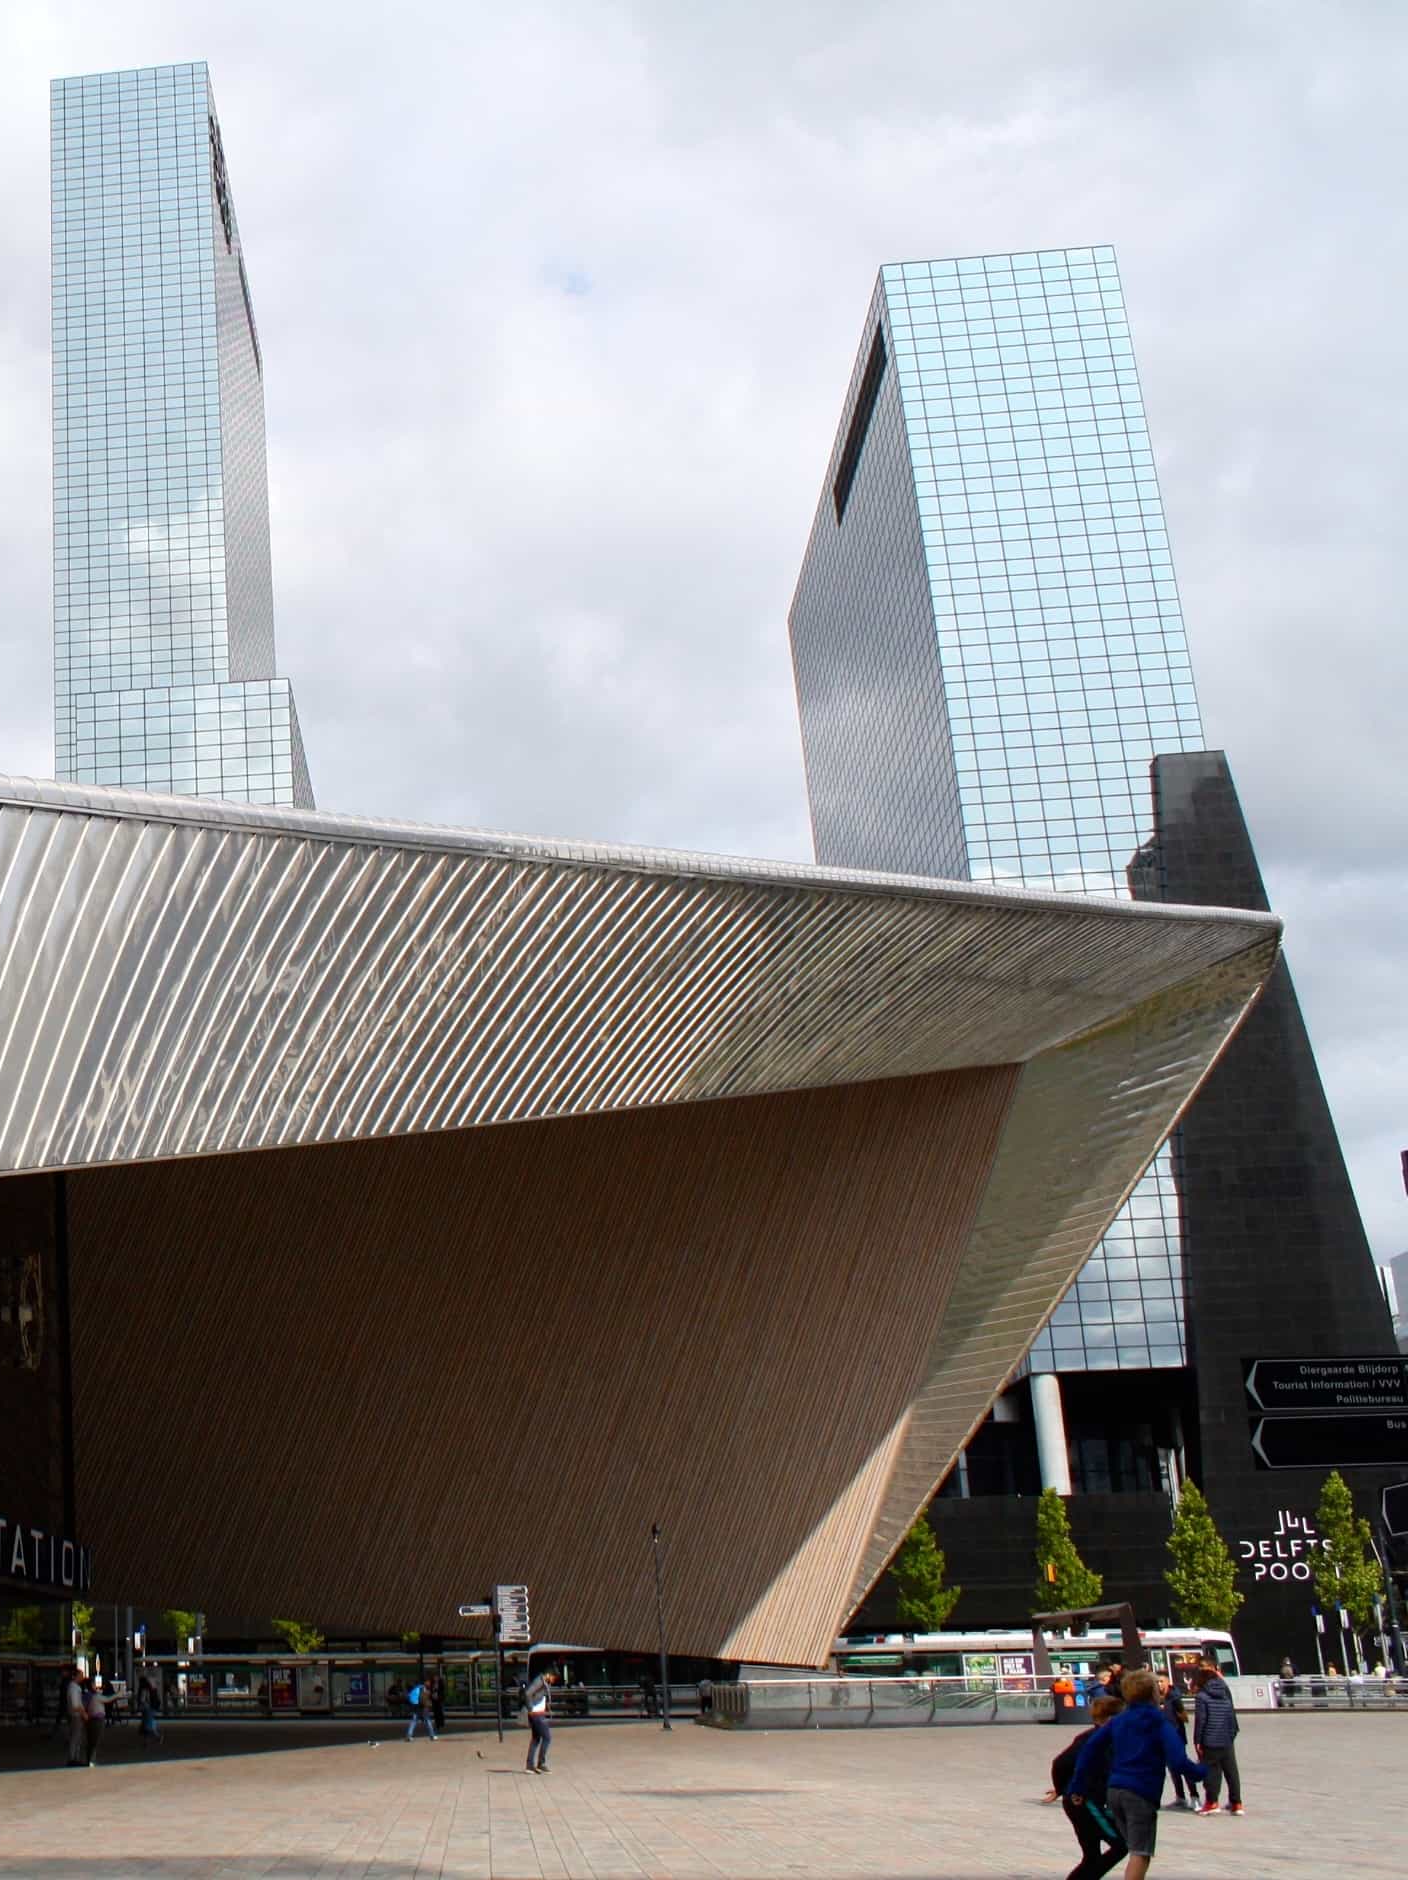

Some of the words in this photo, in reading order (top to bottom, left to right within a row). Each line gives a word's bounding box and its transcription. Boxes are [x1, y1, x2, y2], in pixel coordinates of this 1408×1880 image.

[1299, 1365, 1354, 1376] Diergaarde
[1358, 1364, 1398, 1376] Blijdorp
[1273, 1380, 1308, 1390] Tourist
[1310, 1379, 1369, 1390] Information
[1379, 1379, 1401, 1387] VVV
[1336, 1394, 1404, 1404] Politiebureau
